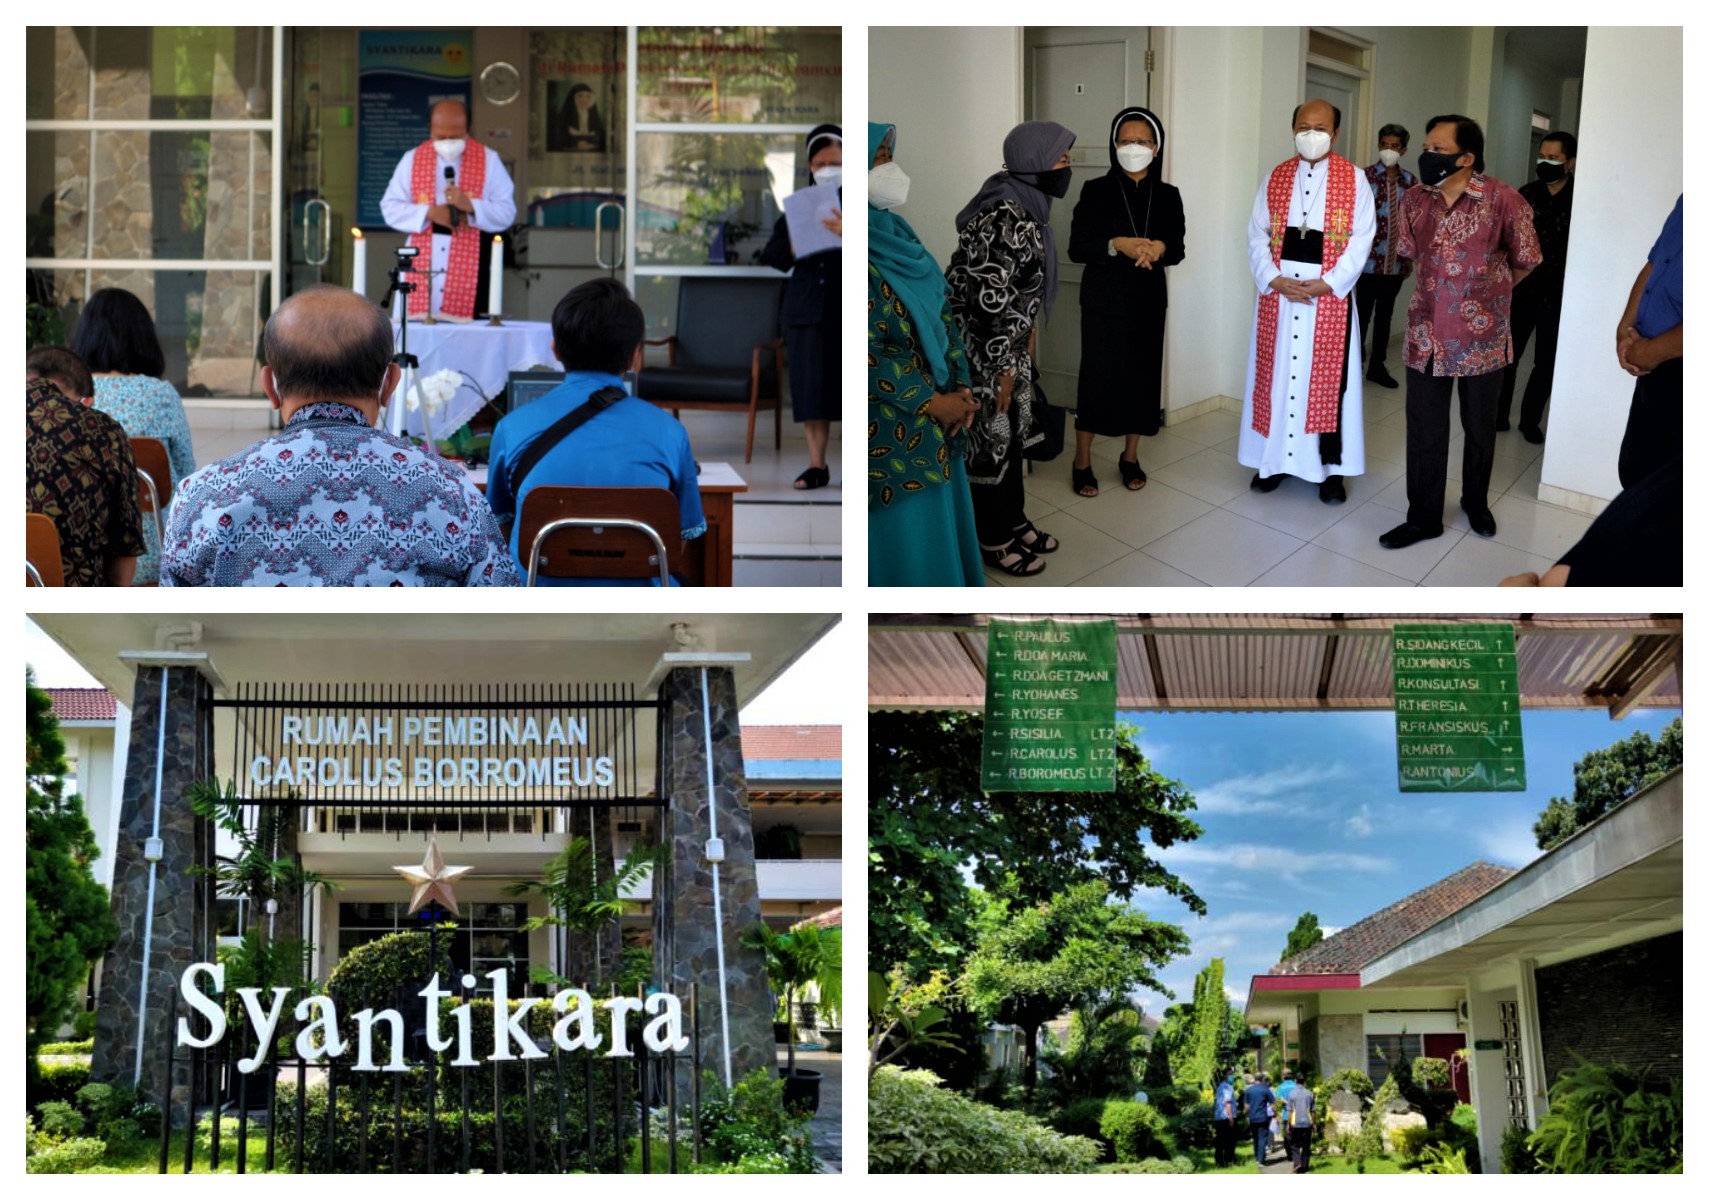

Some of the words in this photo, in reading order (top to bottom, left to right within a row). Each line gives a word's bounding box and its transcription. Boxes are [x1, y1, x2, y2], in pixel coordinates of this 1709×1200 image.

[1451, 639, 1485, 651] KECIL
[283, 716, 394, 746] RUMAH
[403, 716, 588, 746] PEMBINAAN
[250, 756, 404, 787] CAROLUS
[413, 756, 616, 788] BORROMEUS
[177, 960, 690, 1075] Syantikara
